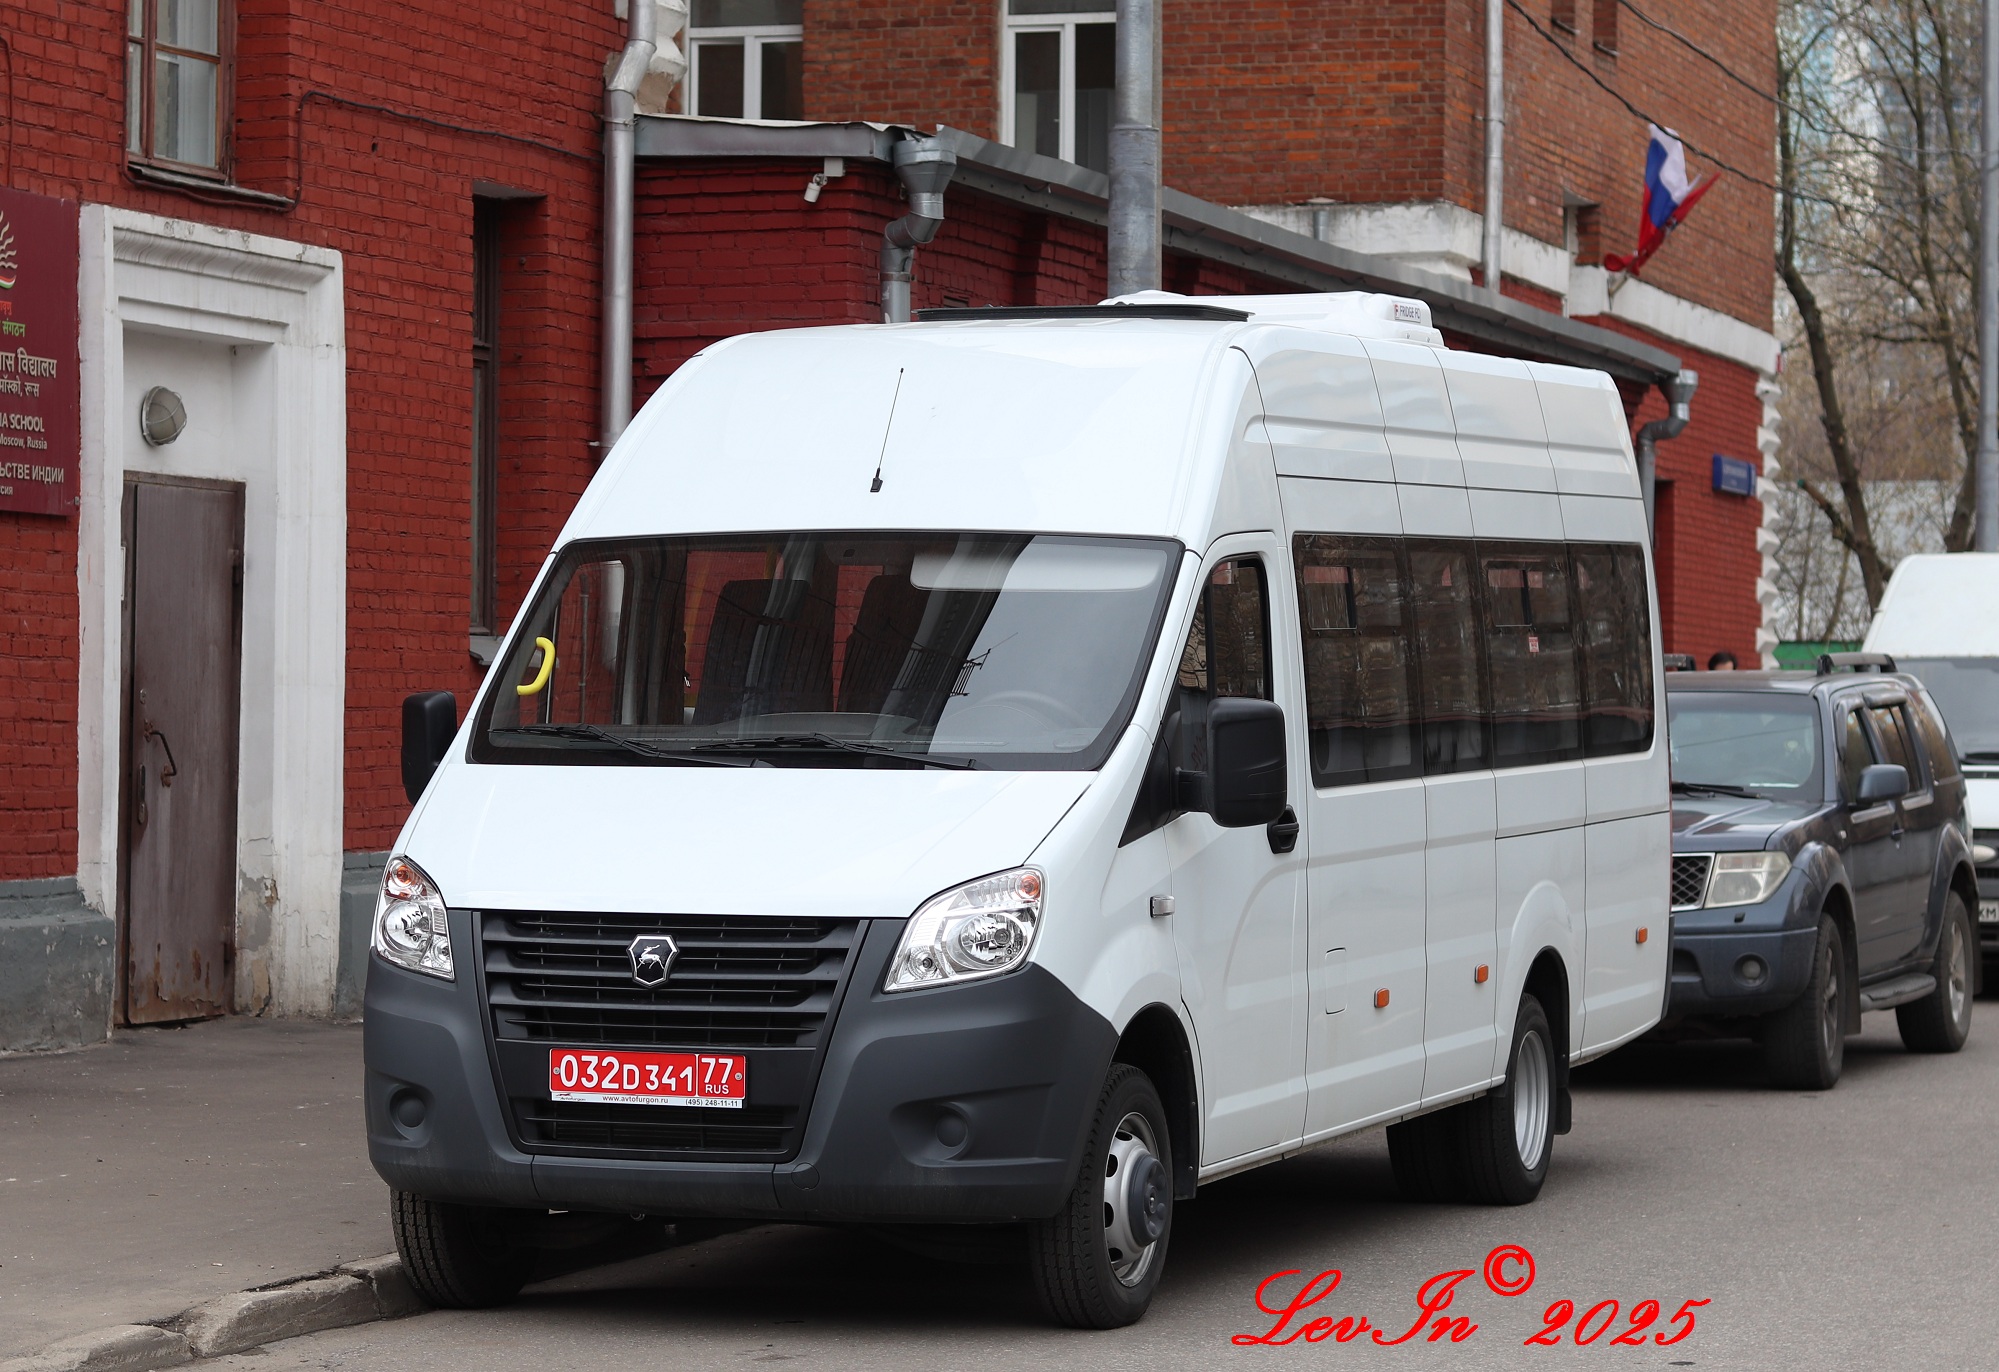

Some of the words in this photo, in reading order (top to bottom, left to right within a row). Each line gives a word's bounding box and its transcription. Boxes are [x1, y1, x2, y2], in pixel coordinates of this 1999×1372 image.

[2, 318, 25, 338] संगठन
[17, 346, 57, 379] विद्यालय
[9, 413, 45, 432] SCHOOL
[26, 436, 48, 450] Russia
[32, 464, 64, 484] ИНДИИ
[701, 1057, 734, 1084] 77
[705, 1084, 730, 1095] RUS
[602, 1095, 669, 1105] www.avtofurgon.ru
[685, 1099, 703, 1107] (495)
[705, 1099, 738, 1107] 248-11-11
